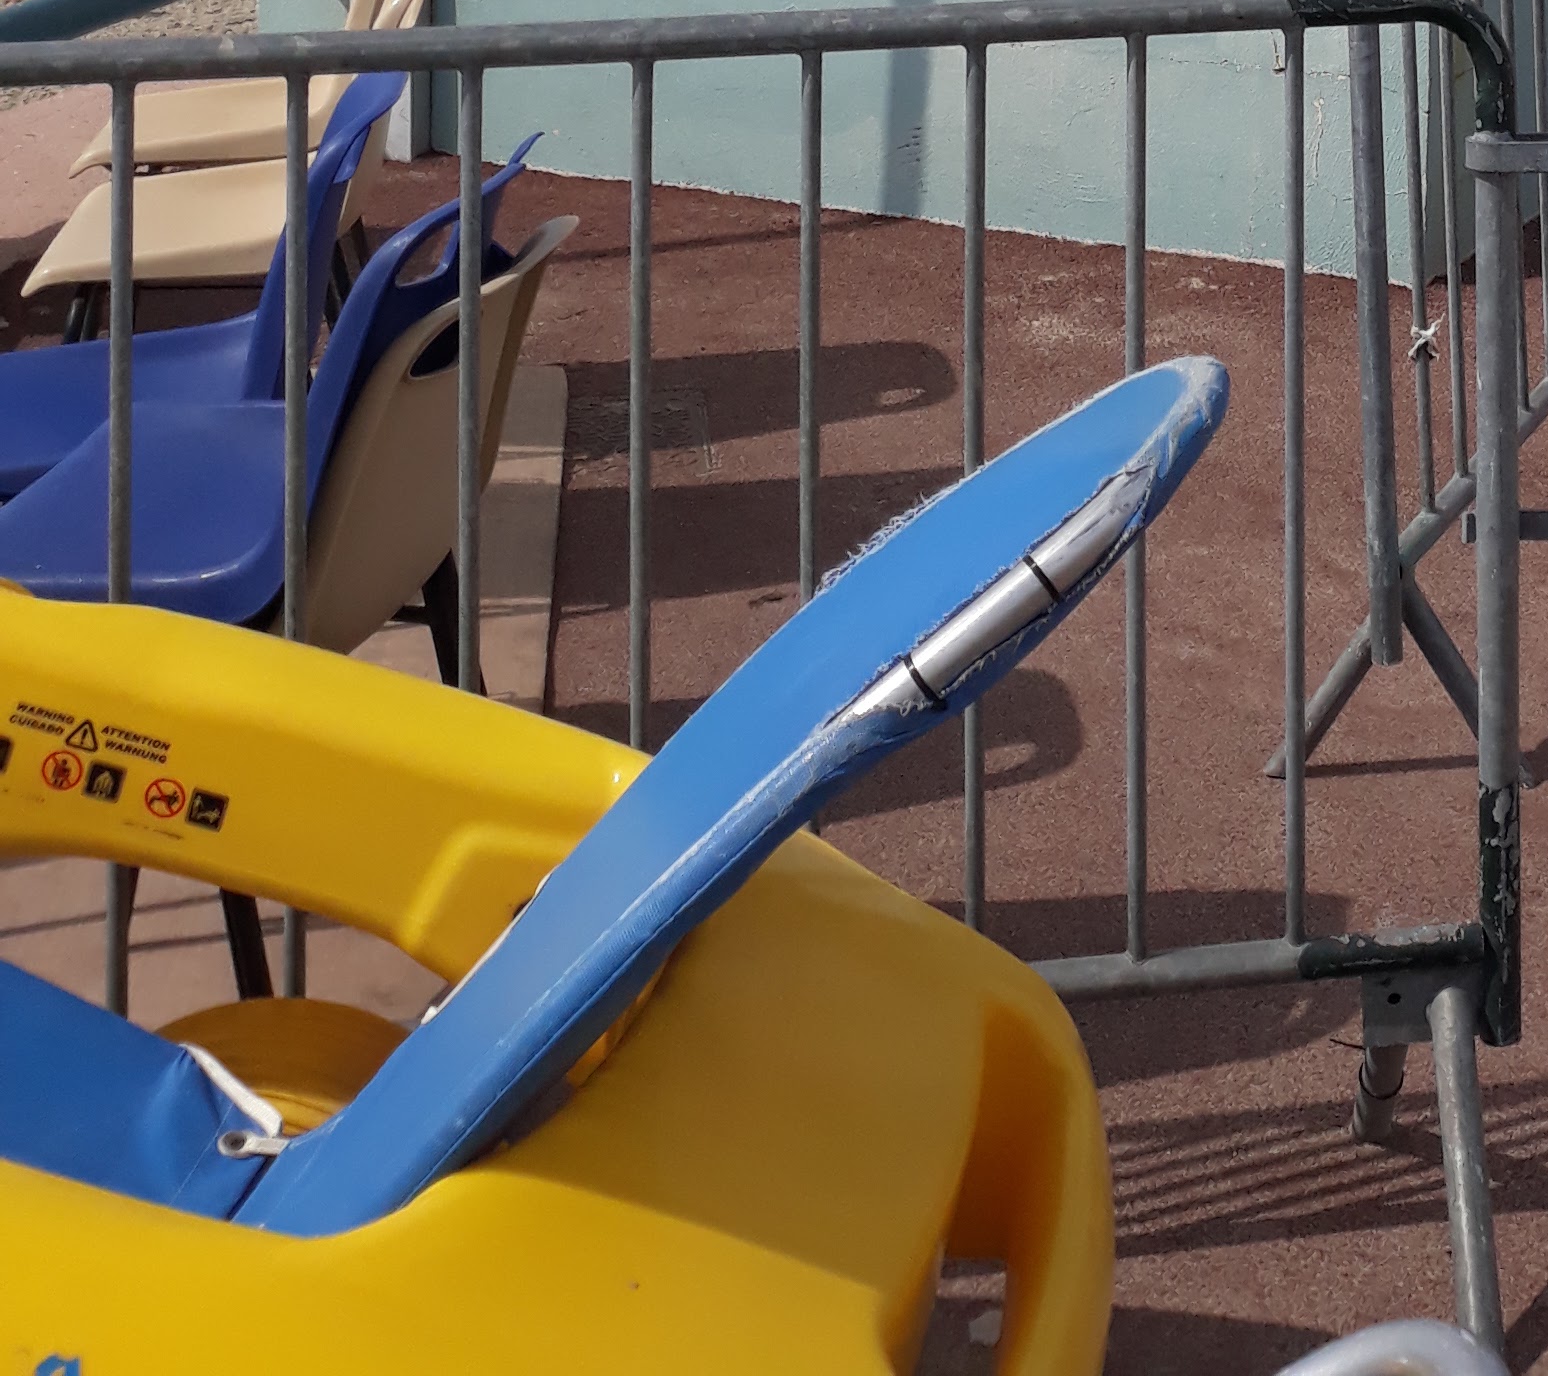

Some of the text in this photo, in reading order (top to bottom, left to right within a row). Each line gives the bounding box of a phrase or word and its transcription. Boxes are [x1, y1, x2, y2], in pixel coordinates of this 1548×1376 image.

[9, 714, 65, 736] CUIDADO
[17, 702, 75, 725] WARNING
[101, 725, 171, 751] ATTENTION
[105, 739, 168, 765] WARNUNG
